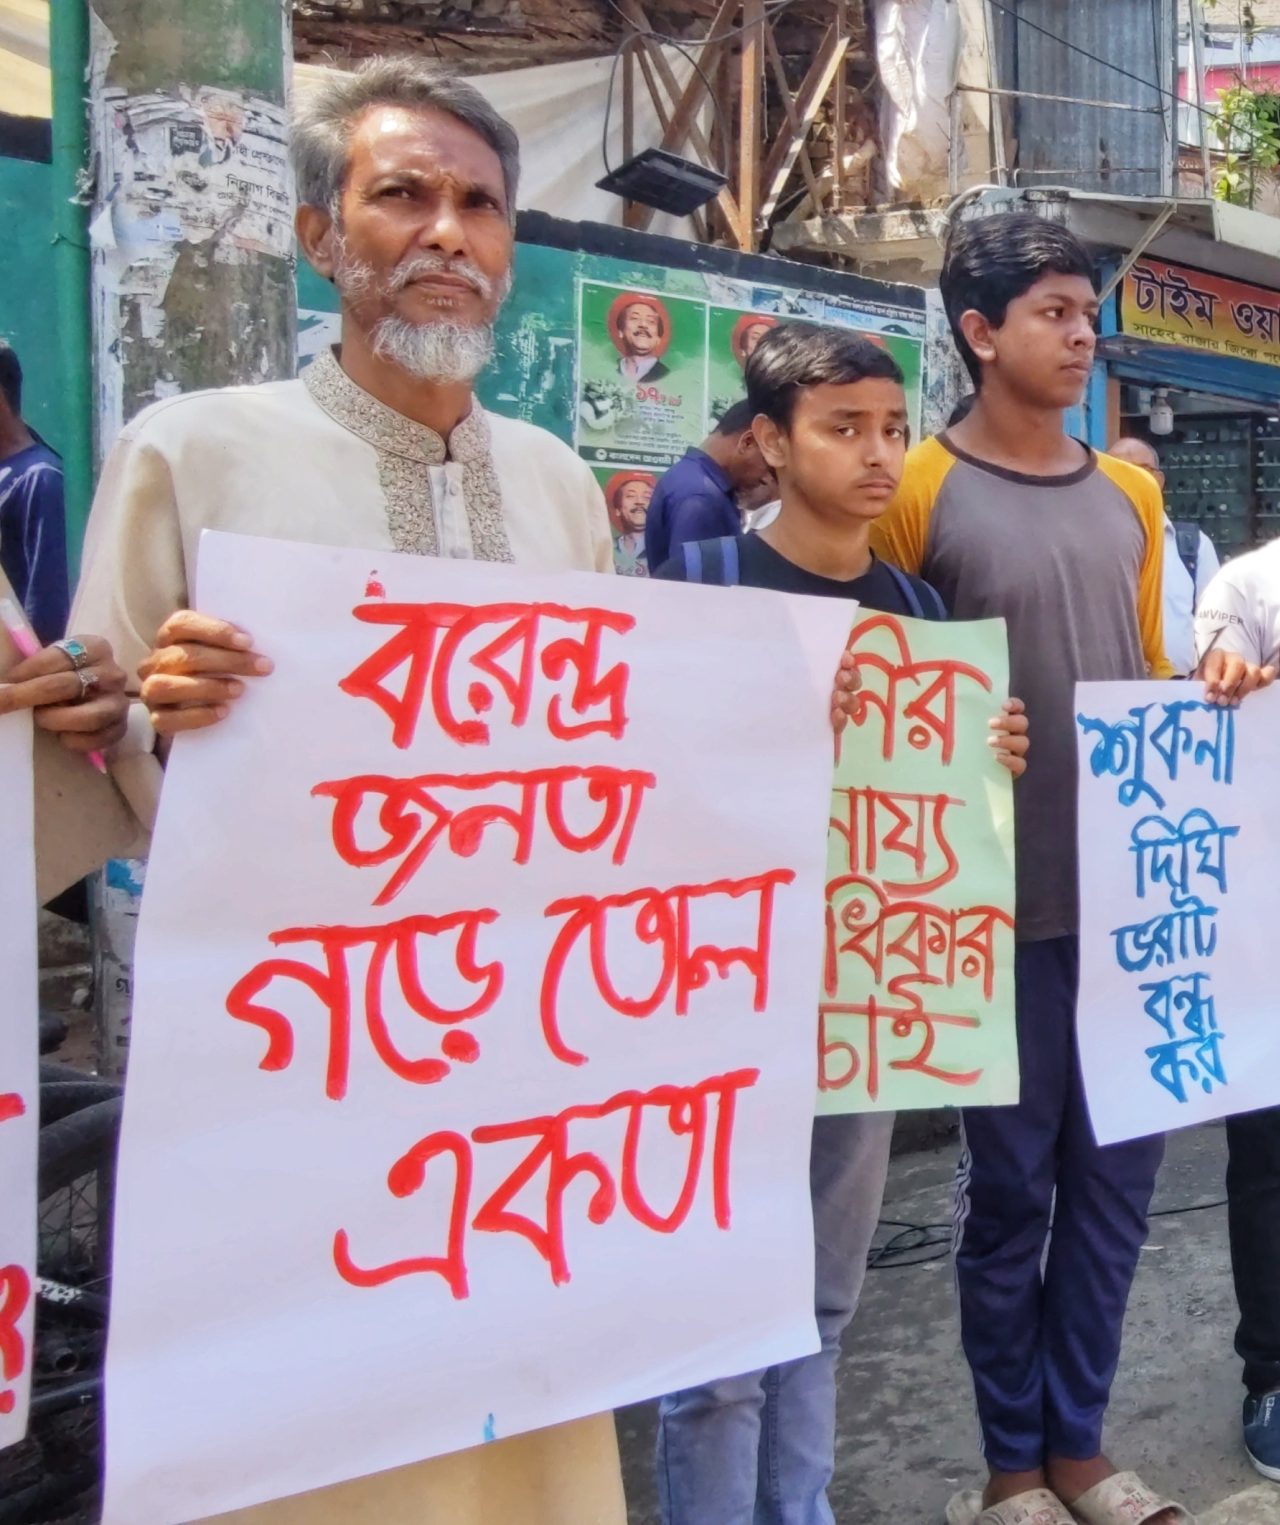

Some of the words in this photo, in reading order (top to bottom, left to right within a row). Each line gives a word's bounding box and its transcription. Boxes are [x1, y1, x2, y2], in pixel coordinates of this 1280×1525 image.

[1131, 265, 1219, 328] টাইম
[337, 598, 636, 749] বরেন্দ্র
[1077, 699, 1240, 809] শুকনা
[310, 766, 657, 907] জনতা
[1128, 808, 1240, 898] দিঘি
[224, 908, 504, 1101] গড়ে
[540, 869, 795, 1066] তোল
[824, 874, 1015, 1002] ধিকার
[1110, 889, 1218, 972] ভরাট
[818, 974, 983, 1101] চাই
[1138, 971, 1217, 1039] বন্ধ
[1145, 1032, 1227, 1103] কর
[334, 1068, 759, 1300] একতা
